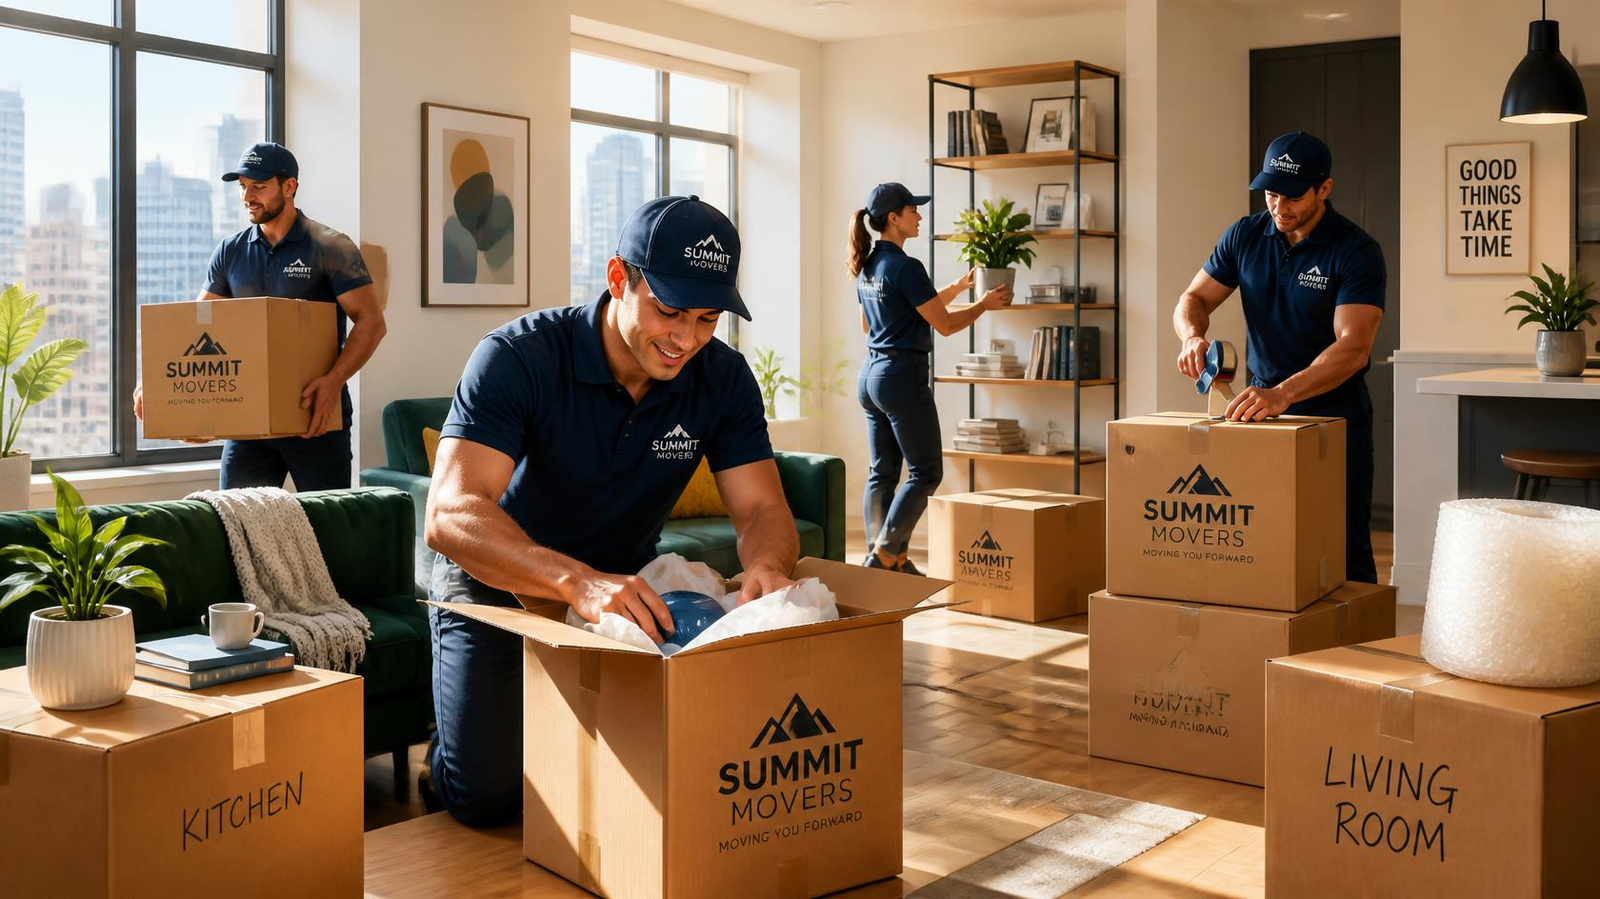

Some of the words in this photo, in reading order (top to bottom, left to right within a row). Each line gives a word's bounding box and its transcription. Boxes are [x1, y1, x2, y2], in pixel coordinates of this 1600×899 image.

[1460, 158, 1517, 181] GOOD
[1459, 184, 1521, 205] THINGS
[1460, 209, 1512, 231] TAKE
[684, 247, 731, 265] SUMMIT
[1460, 235, 1512, 257] TIME
[166, 360, 242, 378] SUMMIT
[173, 379, 237, 393] MOVERS
[652, 439, 700, 451] SUMMIT
[1143, 499, 1254, 526] SUMMIT
[1152, 525, 1244, 548] MOVERS
[958, 549, 1014, 570] SUMMIT
[1143, 549, 1179, 558] MOVING
[1183, 551, 1202, 560] YOU
[1205, 552, 1254, 564] FORWARD
[718, 738, 863, 795] SUMMIT
[1325, 746, 1458, 814] LIVING
[183, 771, 303, 851] KITCHEN
[732, 778, 852, 826] MOVERS
[719, 831, 770, 853] MOVING
[774, 824, 799, 839] YOU
[804, 810, 862, 833] FORWARD
[1336, 802, 1445, 862] ROOM
